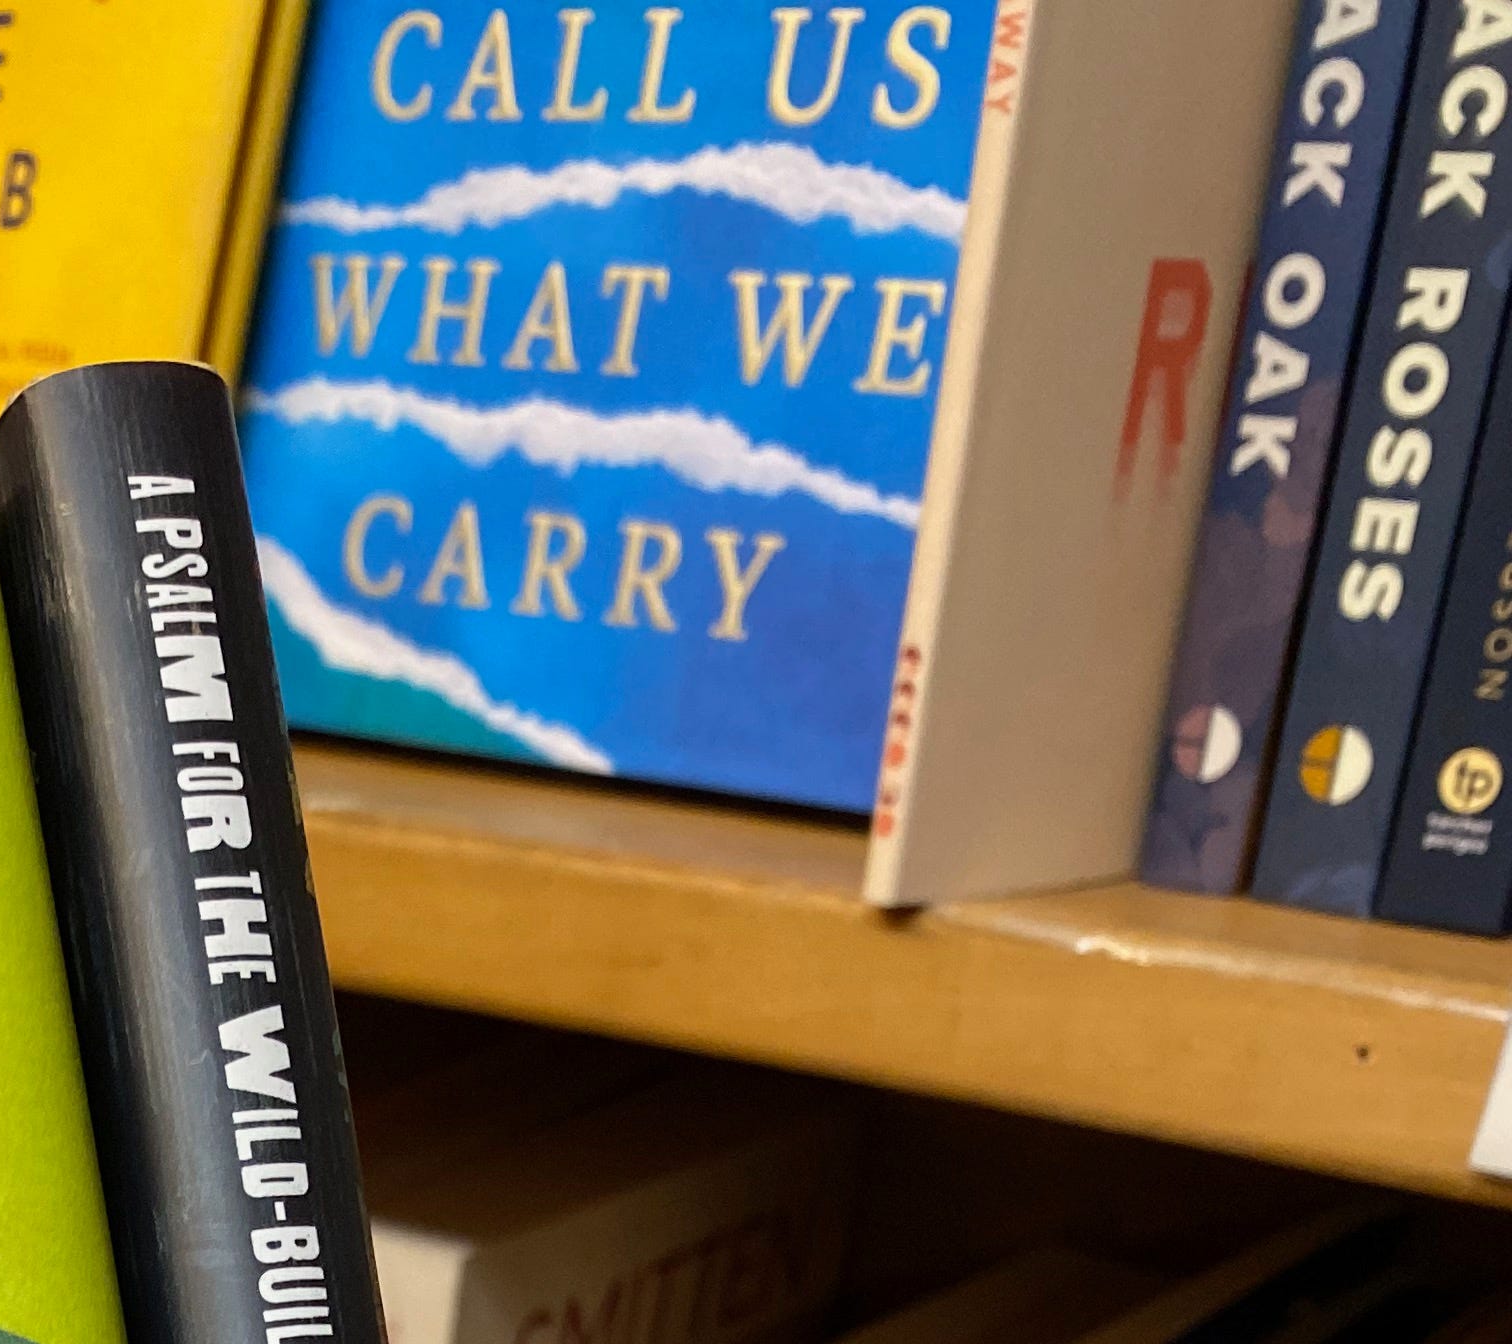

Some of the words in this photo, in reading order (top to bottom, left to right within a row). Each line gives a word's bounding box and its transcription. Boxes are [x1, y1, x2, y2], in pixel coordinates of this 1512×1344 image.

[370, 7, 698, 125] CALL
[766, 4, 955, 129] US
[308, 253, 671, 378] WHAT
[728, 269, 950, 397] WE
[1229, 251, 1327, 478] OAK
[126, 475, 196, 500] A
[1338, 266, 1470, 625] ROSES
[135, 517, 234, 723] PSALM
[343, 496, 787, 642] CARRY
[171, 741, 253, 853] FOR
[194, 870, 277, 985] THE
